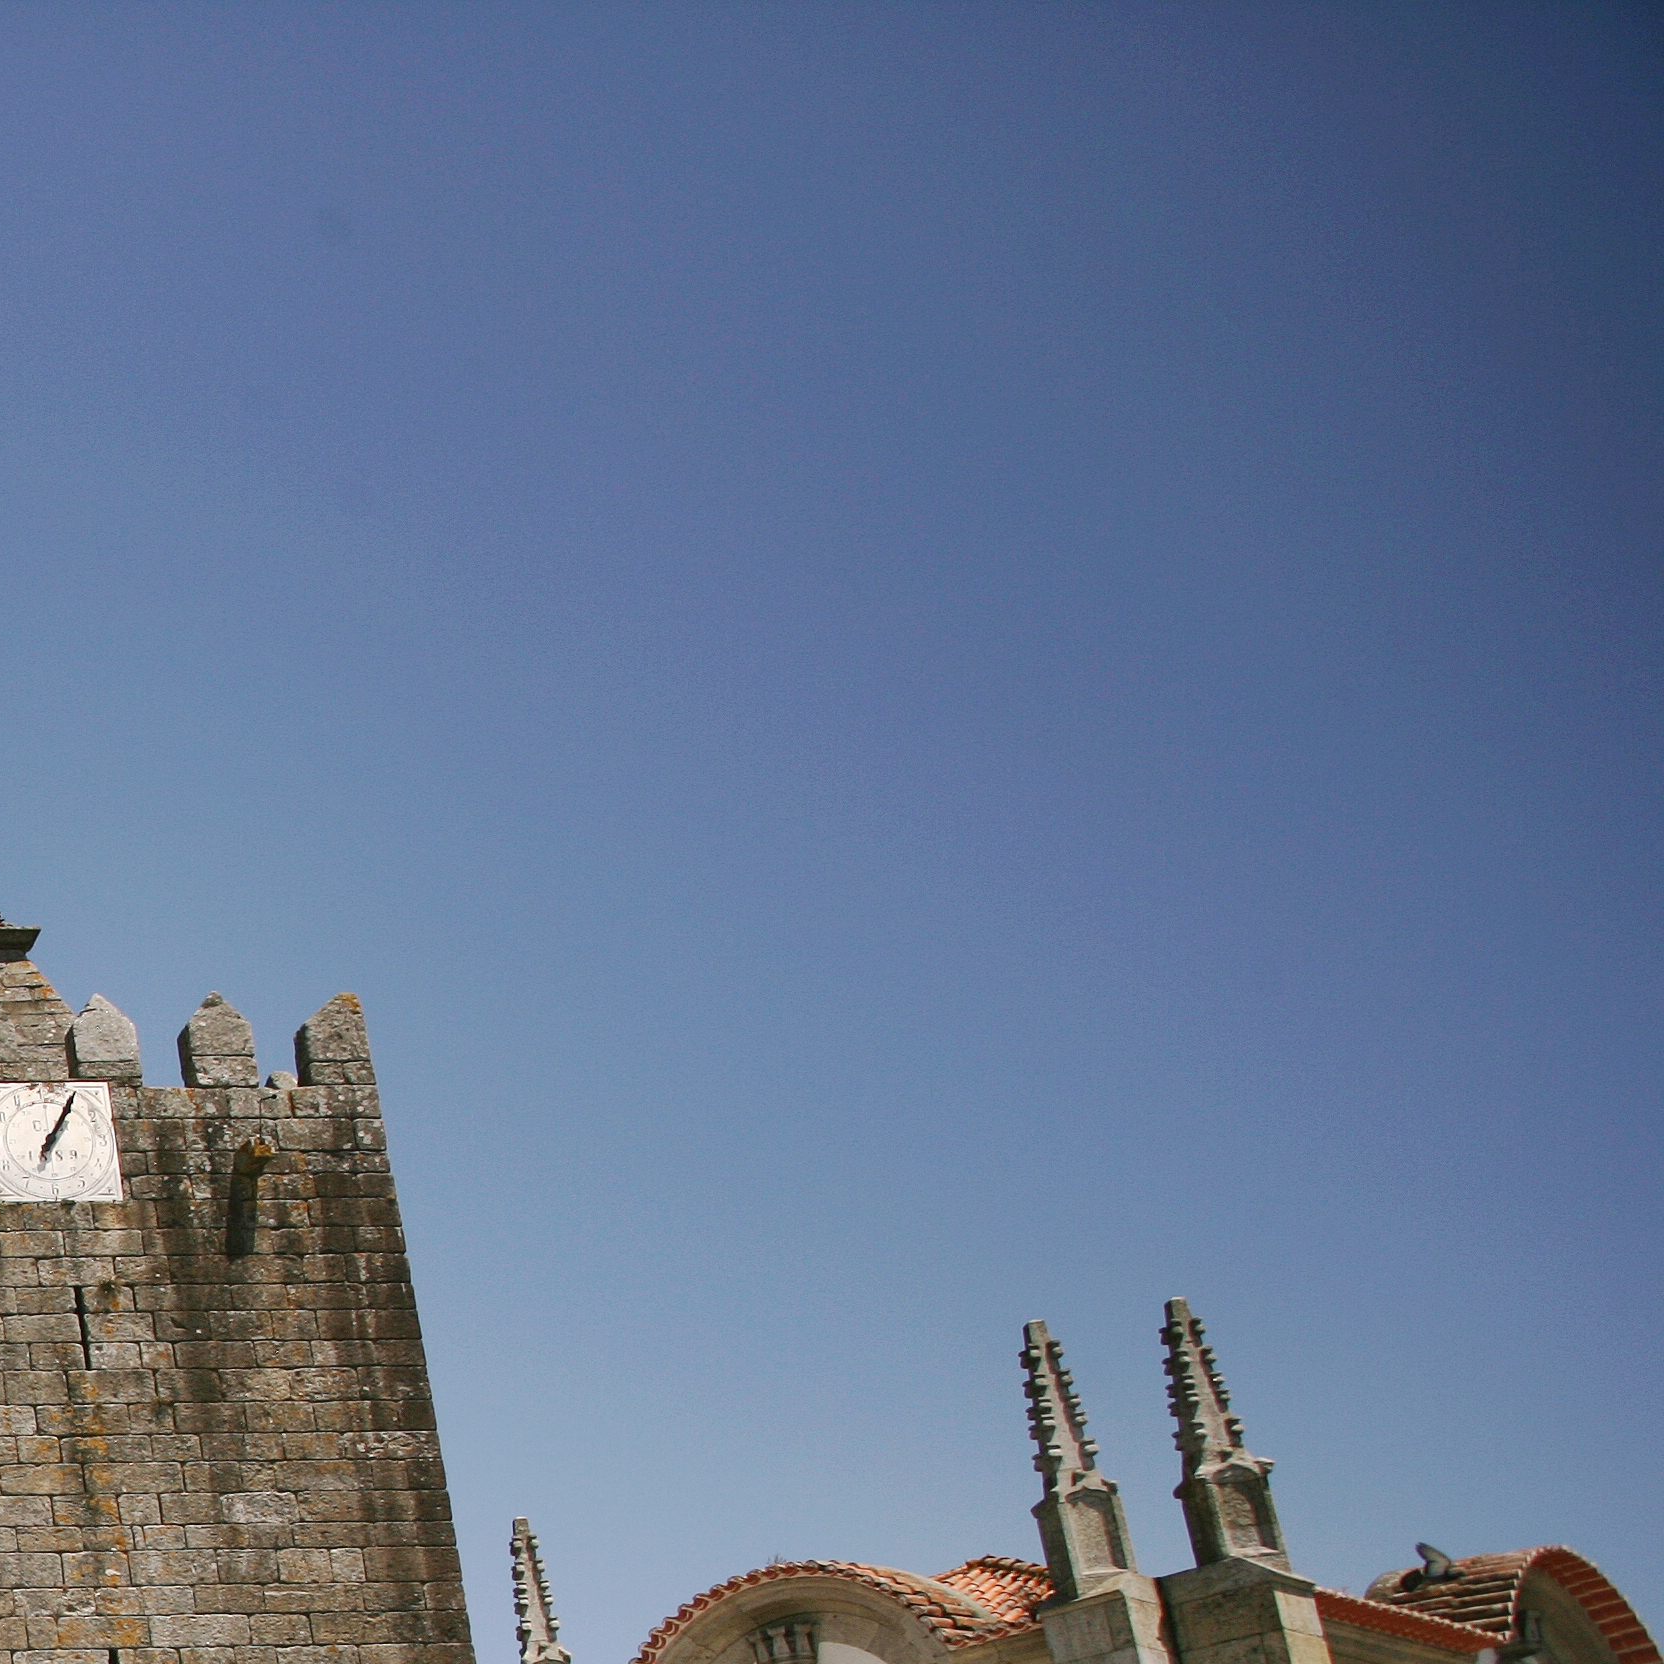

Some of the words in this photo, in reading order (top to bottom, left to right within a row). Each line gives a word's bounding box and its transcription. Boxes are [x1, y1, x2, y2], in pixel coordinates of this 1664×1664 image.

[87, 1110, 97, 1123] 2
[97, 1133, 108, 1147] 3
[28, 1149, 78, 1162] 189
[2, 1160, 10, 1171] 8
[22, 1176, 30, 1189] 7
[75, 1175, 86, 1188] 5
[51, 1182, 60, 1195] 6
